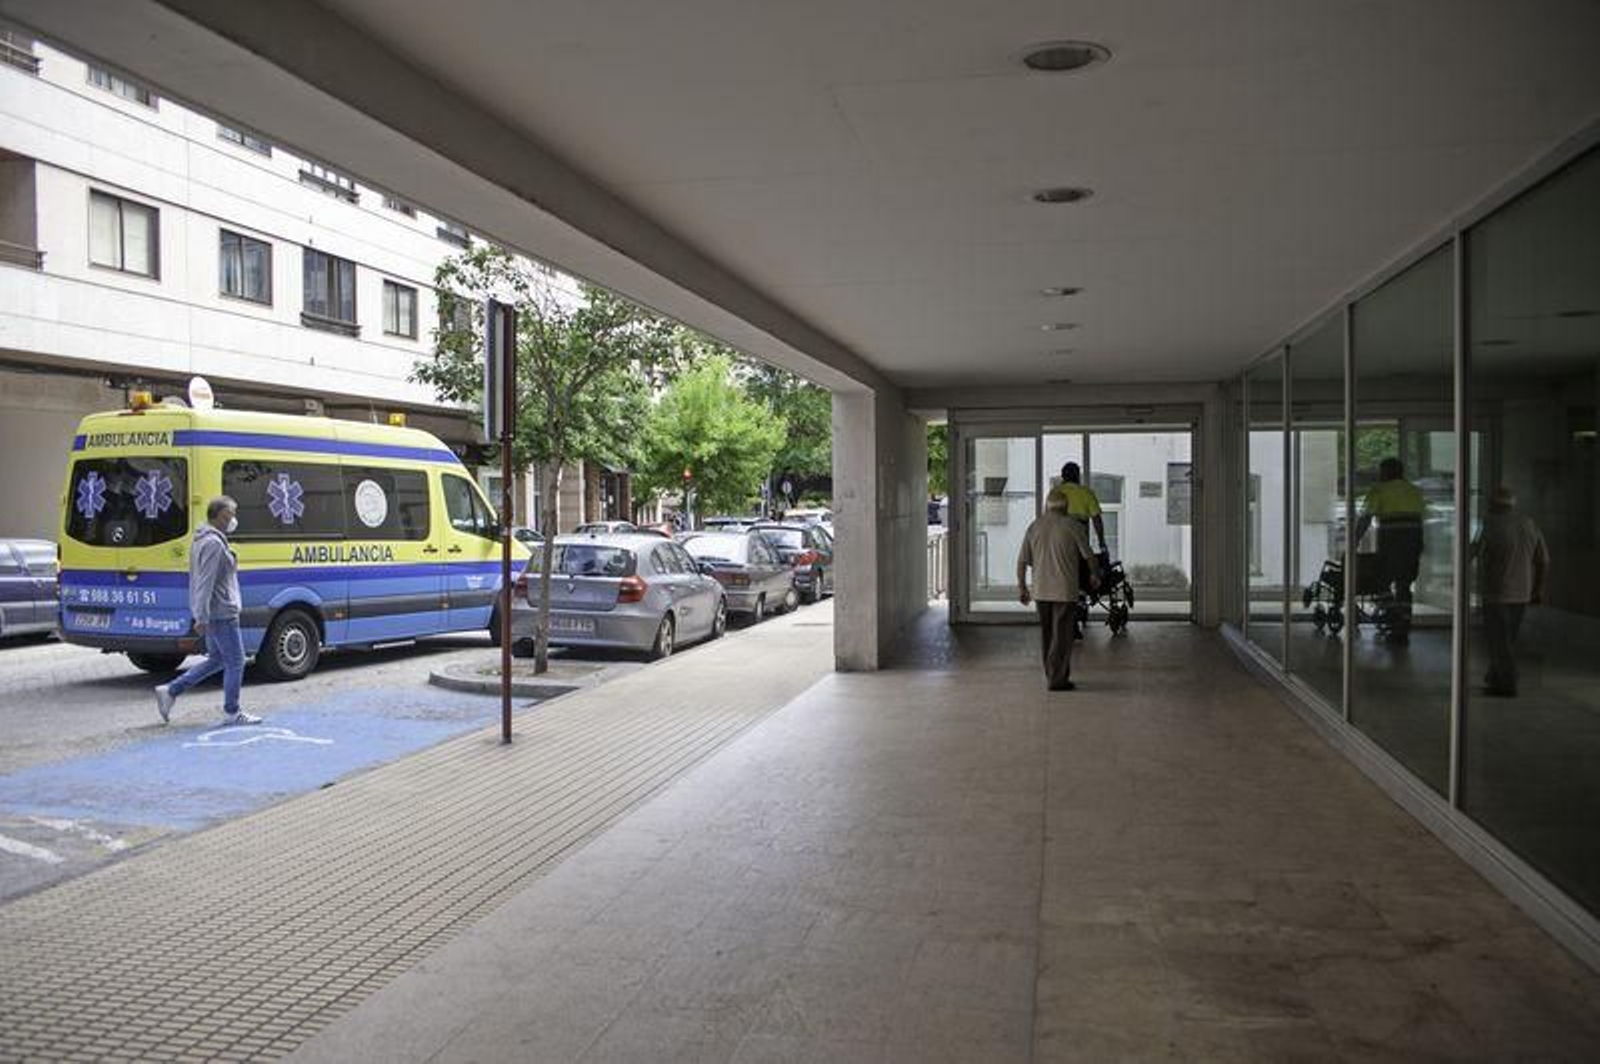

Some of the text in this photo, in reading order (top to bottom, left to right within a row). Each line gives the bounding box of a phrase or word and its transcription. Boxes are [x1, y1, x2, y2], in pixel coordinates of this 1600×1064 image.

[87, 431, 168, 448] AMBULANCIA
[291, 544, 394, 563] AMBULANCIA
[126, 590, 139, 604] 61
[143, 591, 157, 604] 51
